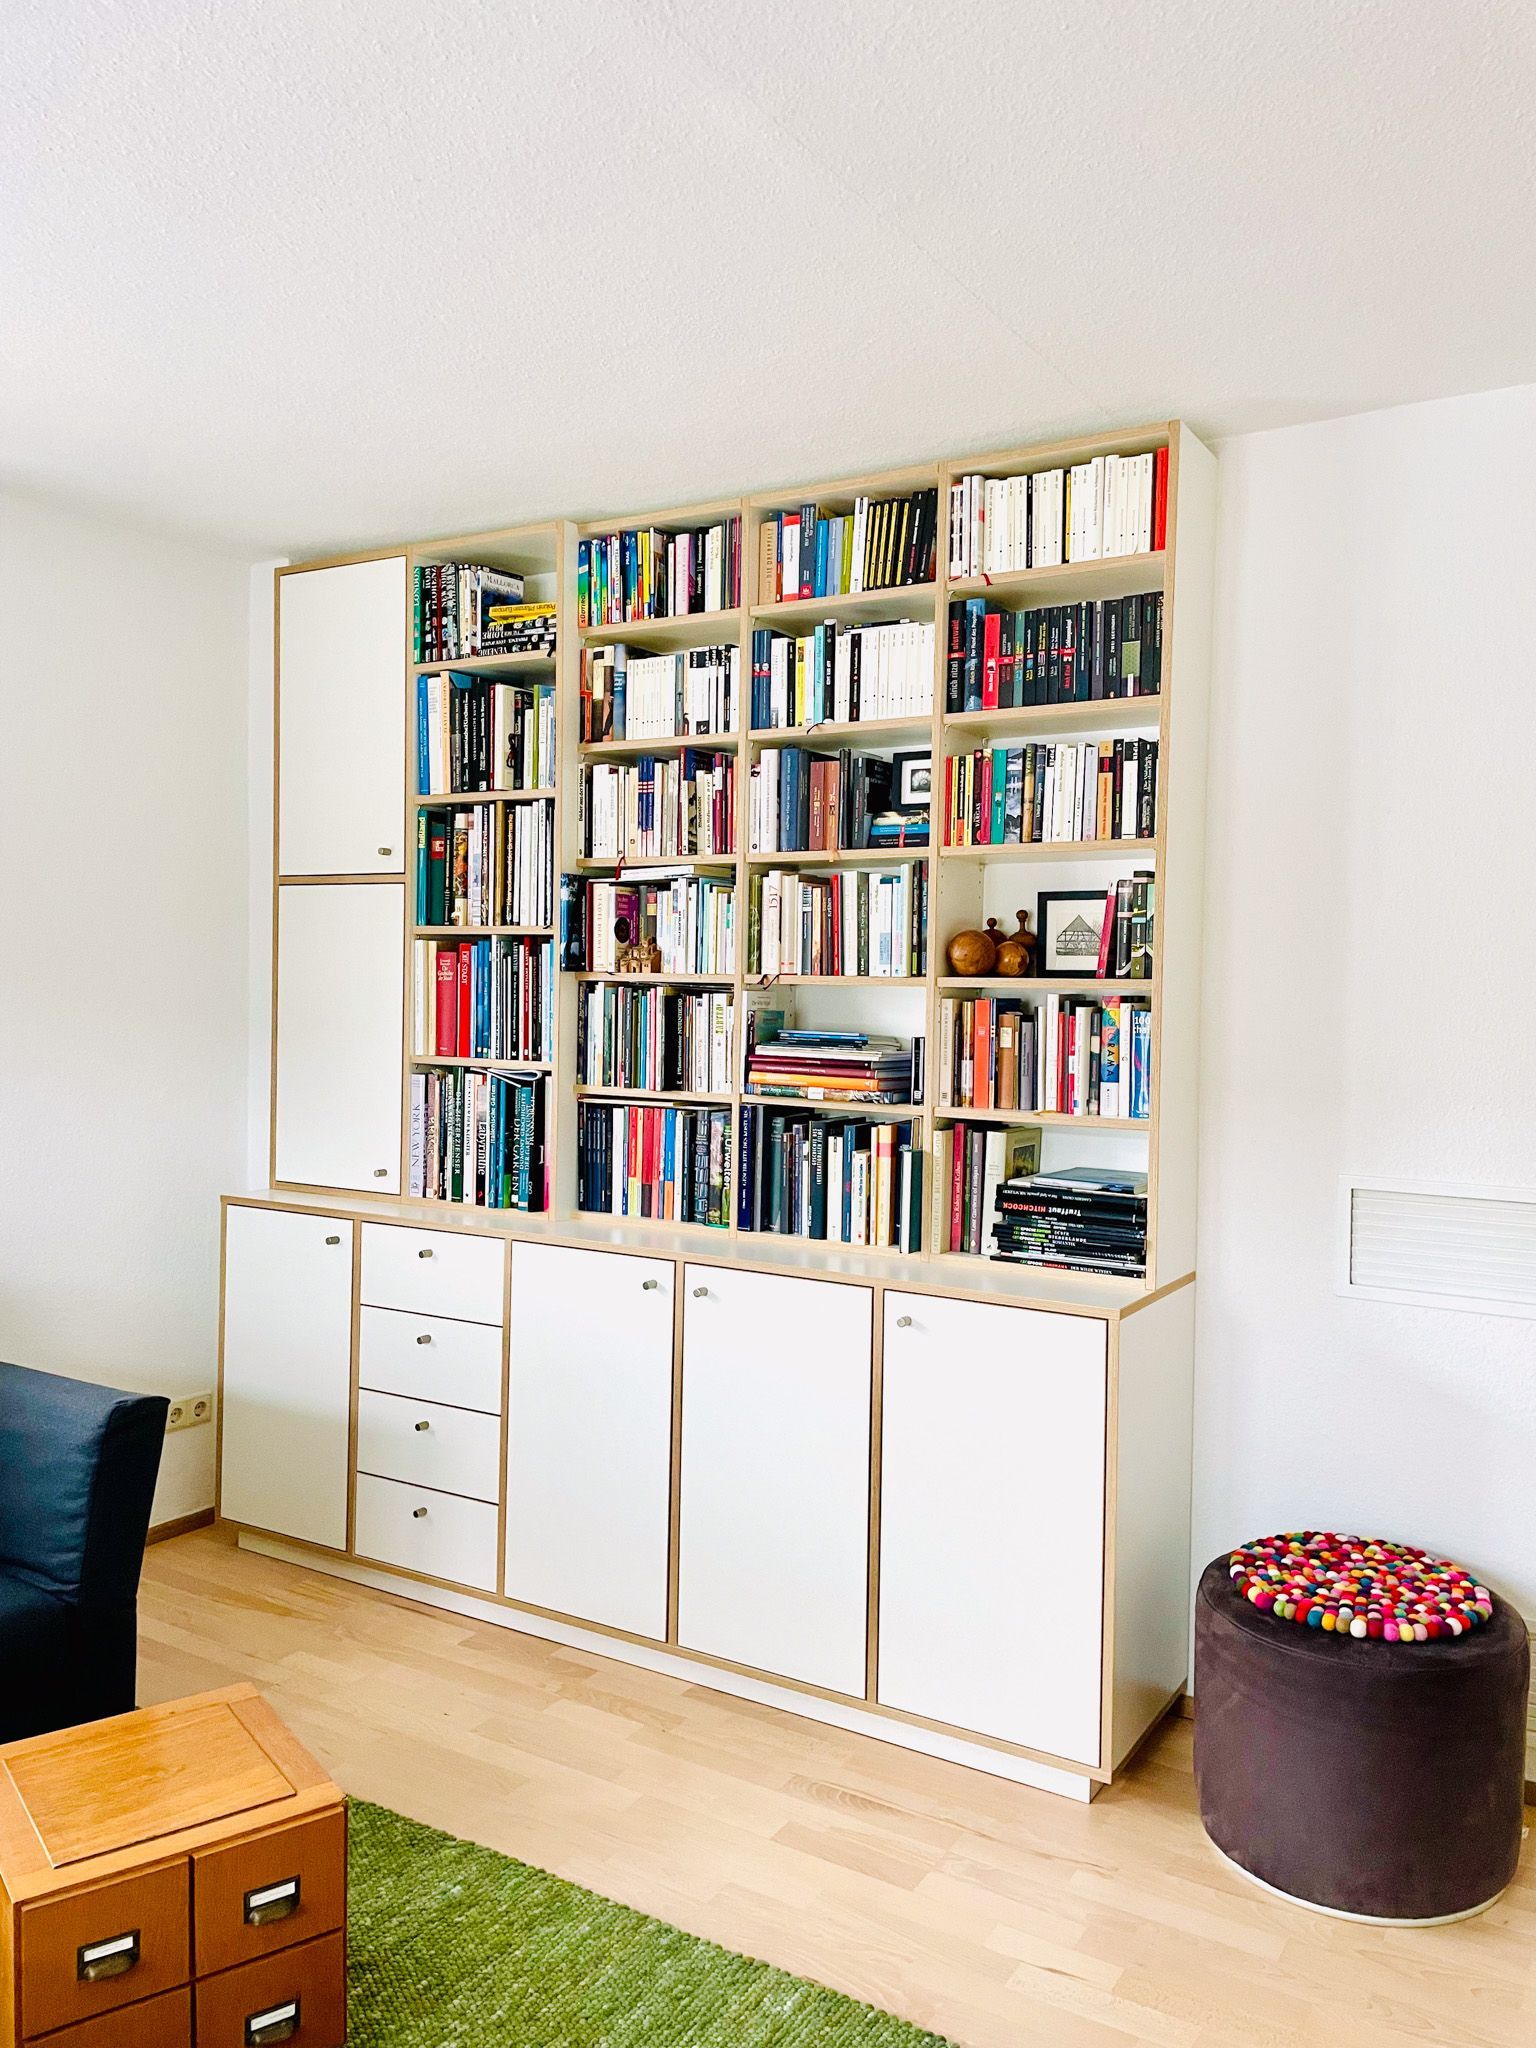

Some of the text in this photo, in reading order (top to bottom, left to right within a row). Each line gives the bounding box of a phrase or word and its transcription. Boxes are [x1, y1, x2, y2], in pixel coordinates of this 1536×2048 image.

[482, 631, 504, 639] LOIRE
[478, 647, 507, 656] VENEDIG
[950, 661, 958, 699] ulrich ritzel
[769, 885, 778, 909] 1517
[1134, 1016, 1151, 1024] 100
[411, 1104, 420, 1167] NEW YORK
[476, 1121, 486, 1175] Labyrinthe
[724, 1139, 732, 1190] Urwelten
[1003, 1202, 1082, 1216] Truffaut HITCHCOCK
